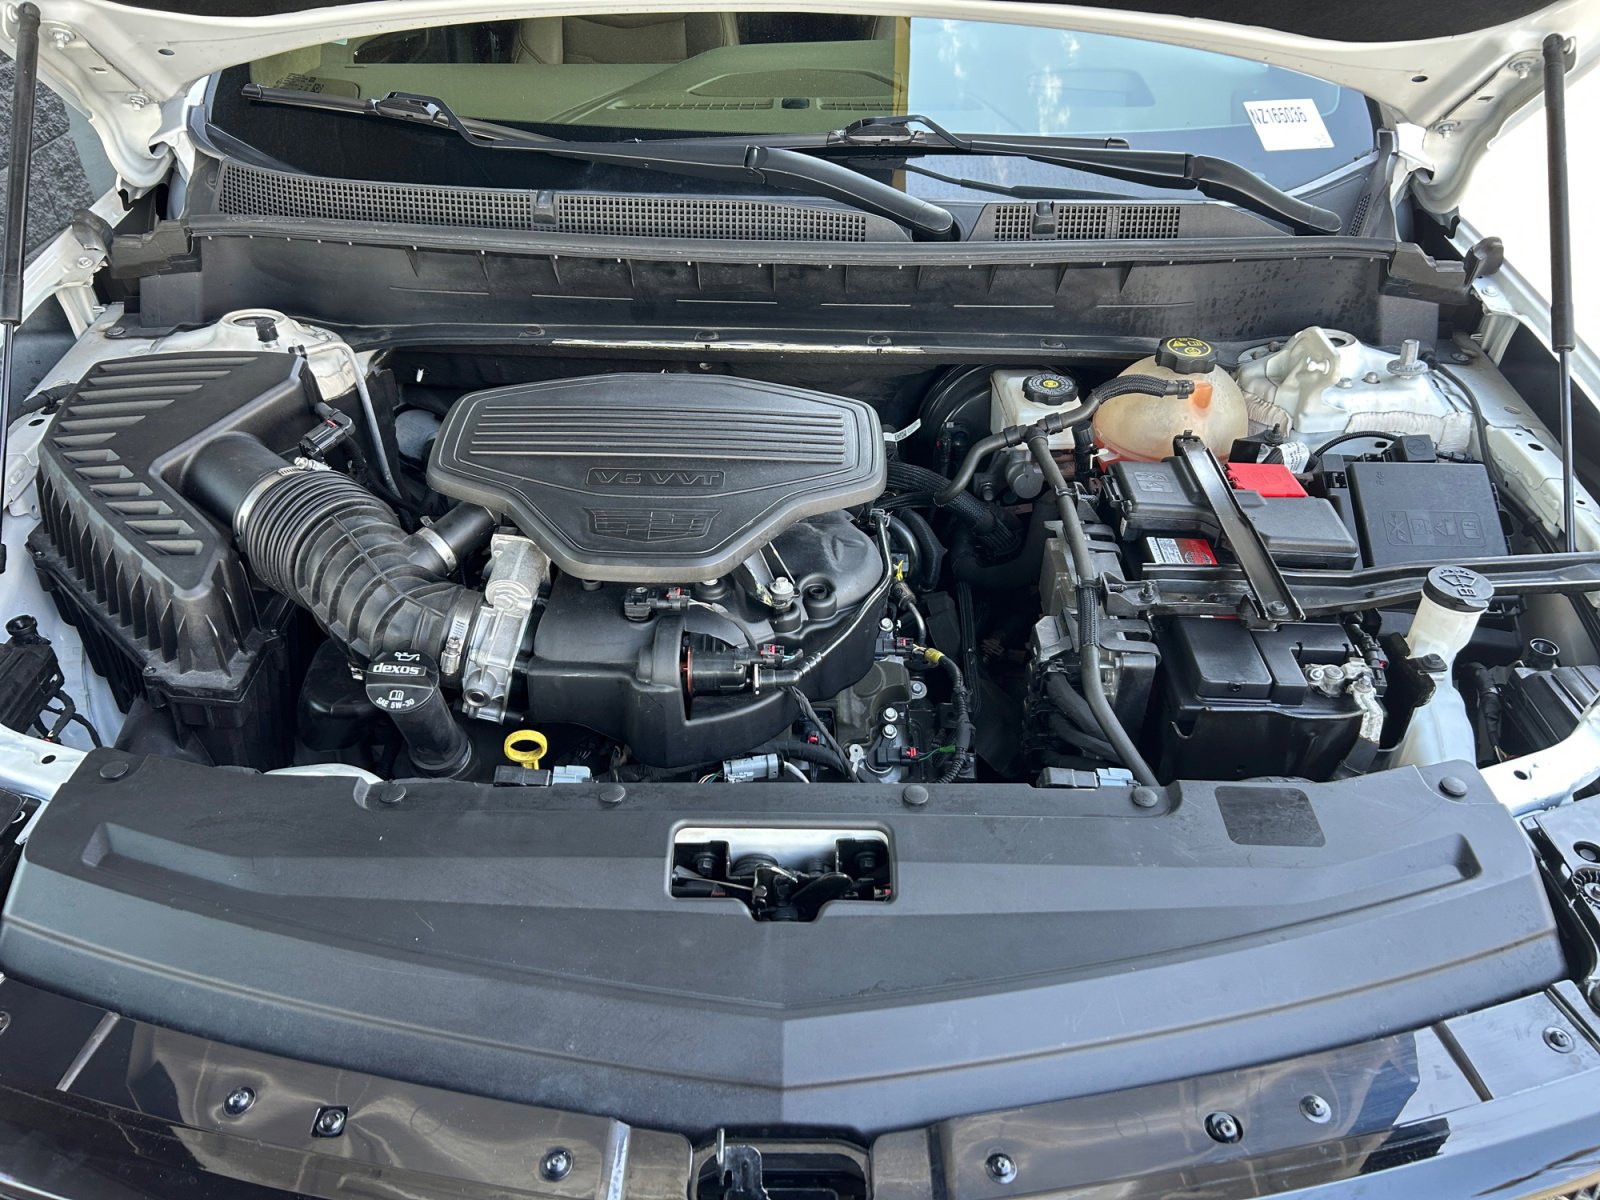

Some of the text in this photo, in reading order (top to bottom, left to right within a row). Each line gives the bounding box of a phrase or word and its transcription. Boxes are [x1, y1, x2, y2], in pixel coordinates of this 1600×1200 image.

[1251, 107, 1307, 124] NZ165036
[594, 471, 719, 485] V6 VVT
[373, 662, 421, 675] dexos
[376, 697, 415, 709] SAE 5W-30
